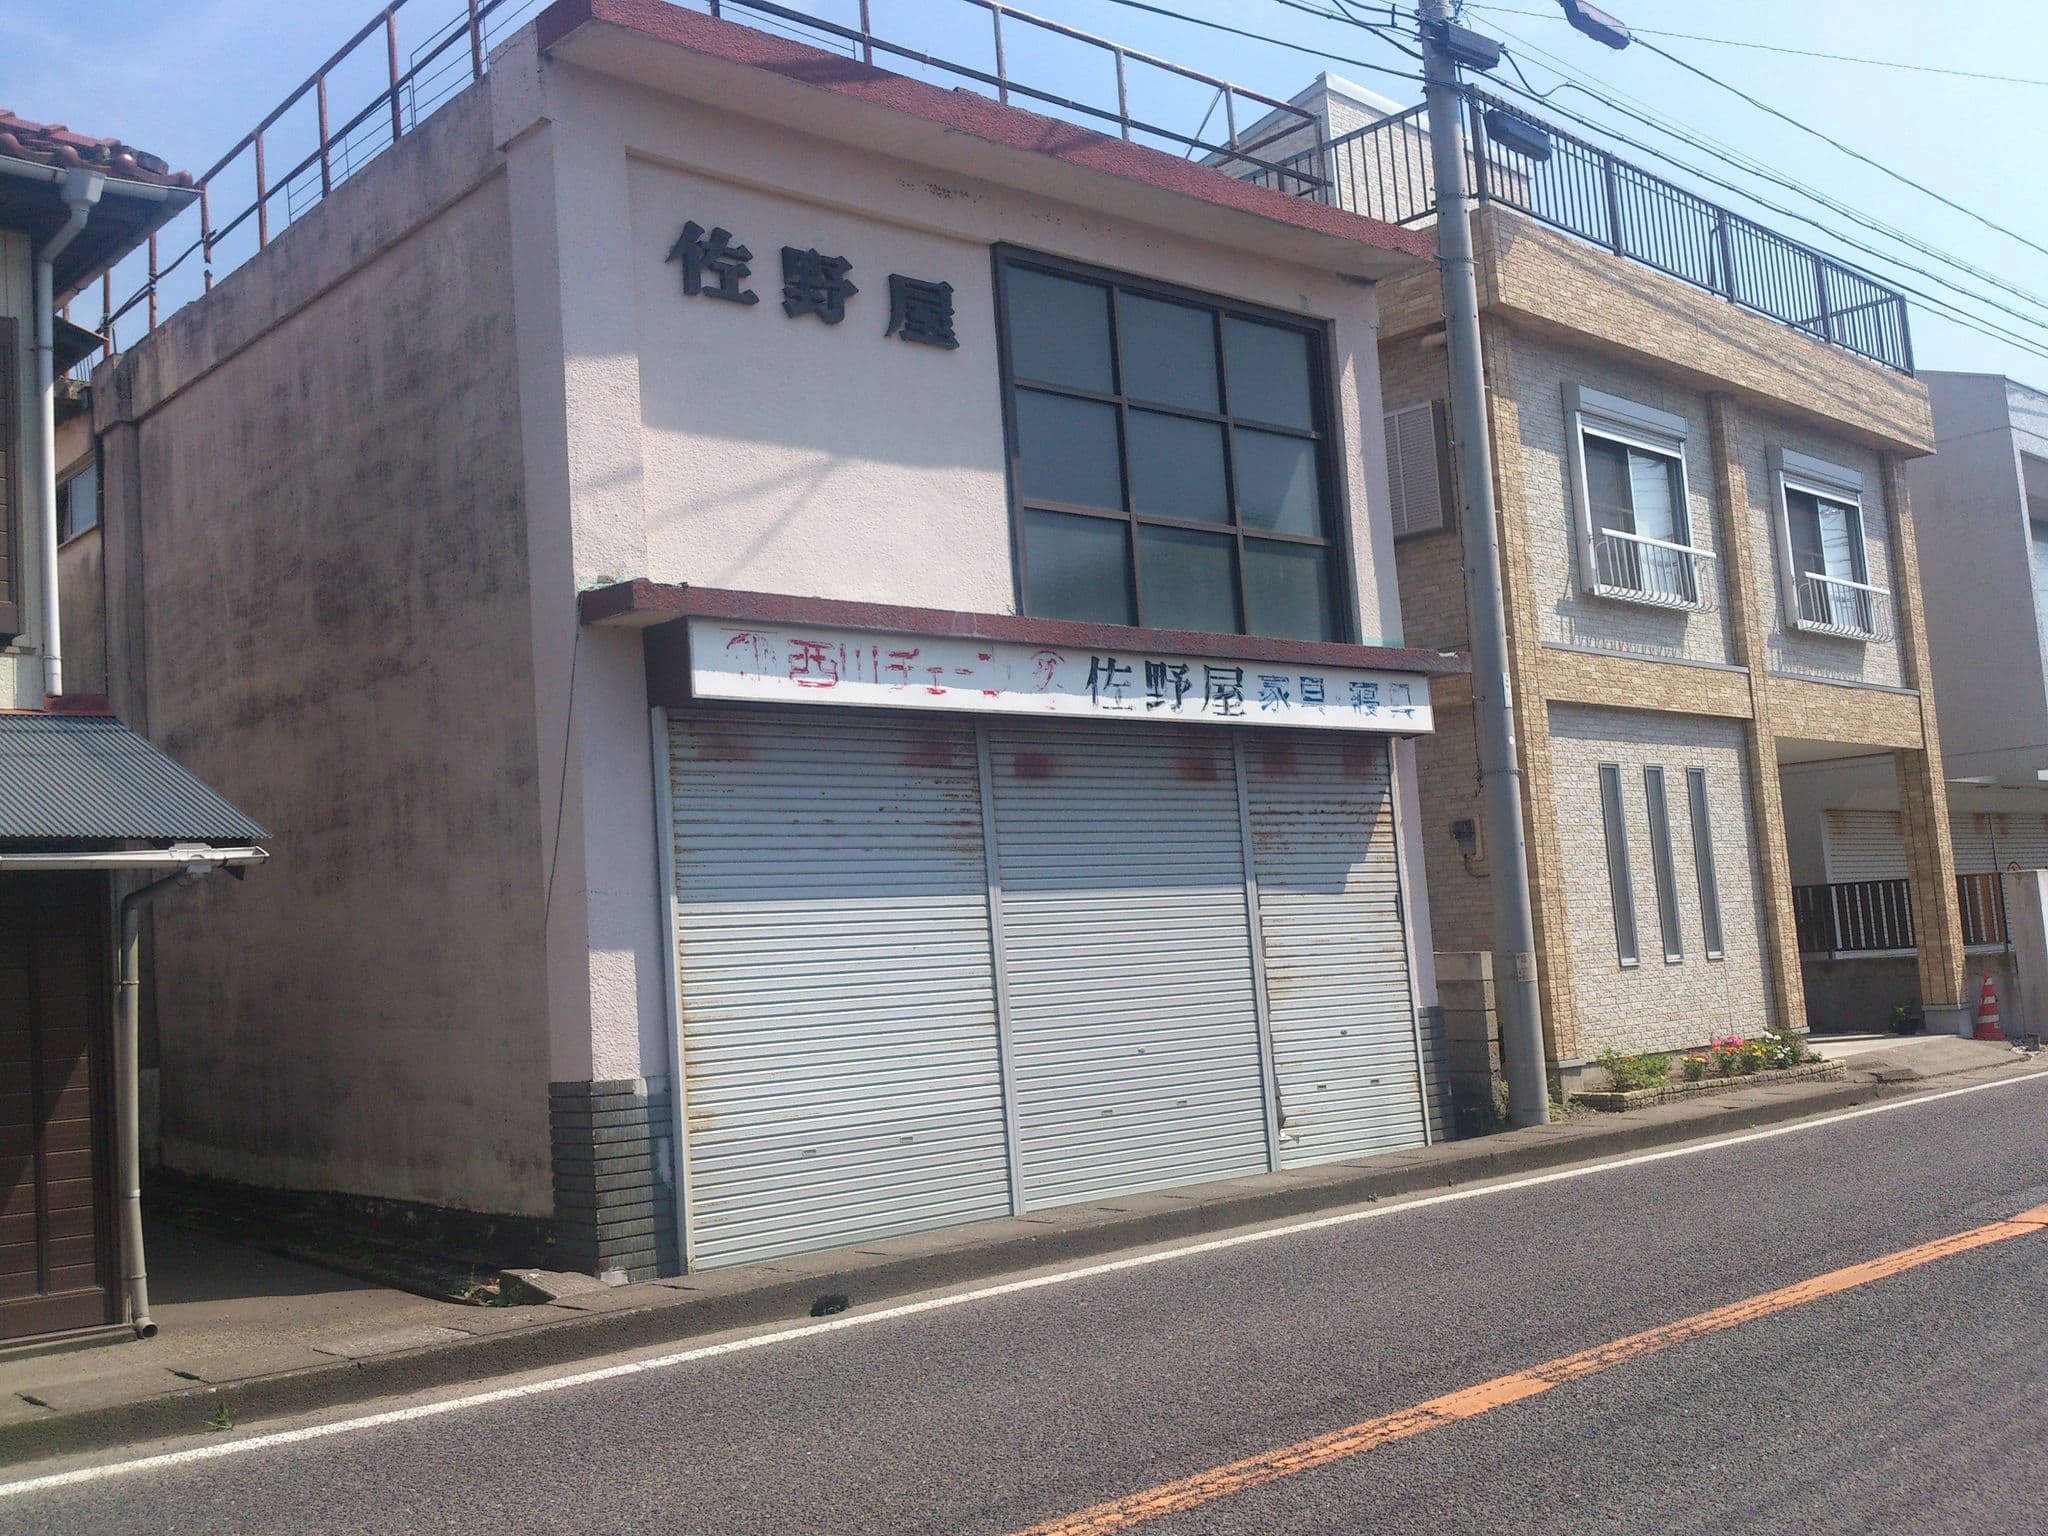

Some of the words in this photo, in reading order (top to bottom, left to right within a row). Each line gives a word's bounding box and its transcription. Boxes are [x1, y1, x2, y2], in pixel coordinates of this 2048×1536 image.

[665, 220, 960, 350] 佐野屋
[1085, 655, 1247, 717] 佐野屋
